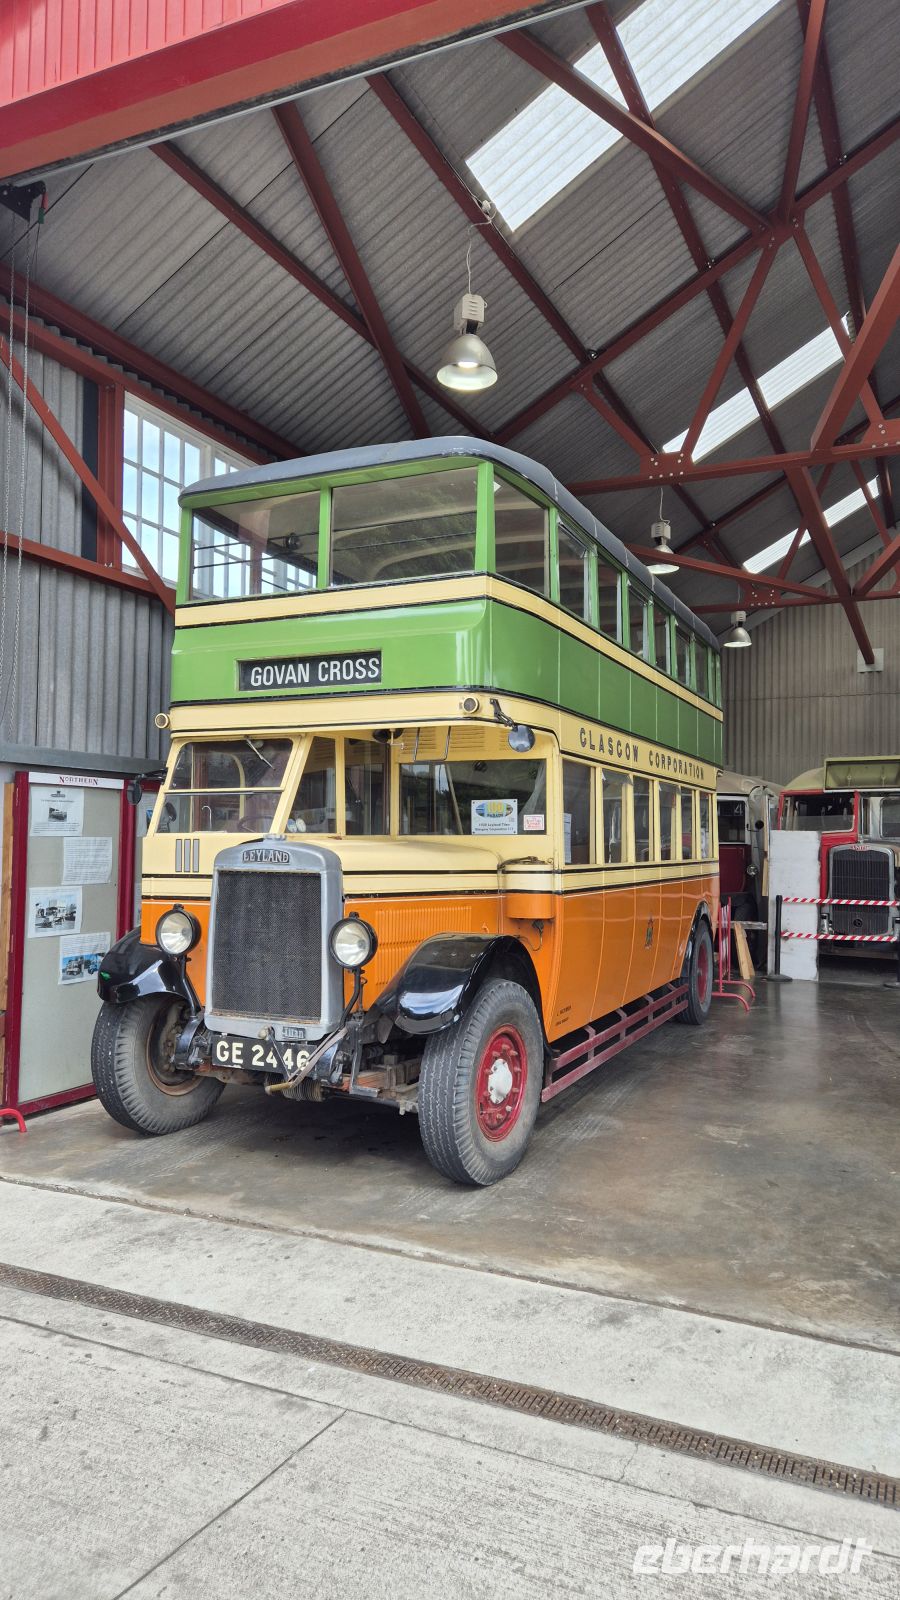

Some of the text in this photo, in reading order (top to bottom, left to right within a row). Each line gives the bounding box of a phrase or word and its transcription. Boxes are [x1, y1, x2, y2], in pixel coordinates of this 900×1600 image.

[250, 657, 380, 687] GOVAN CROSS
[579, 727, 705, 781] GLASGOW CORPORATION
[59, 775, 99, 786] NORTHERN
[243, 849, 289, 863] LEYLAND
[216, 1040, 311, 1071] GE 2446
